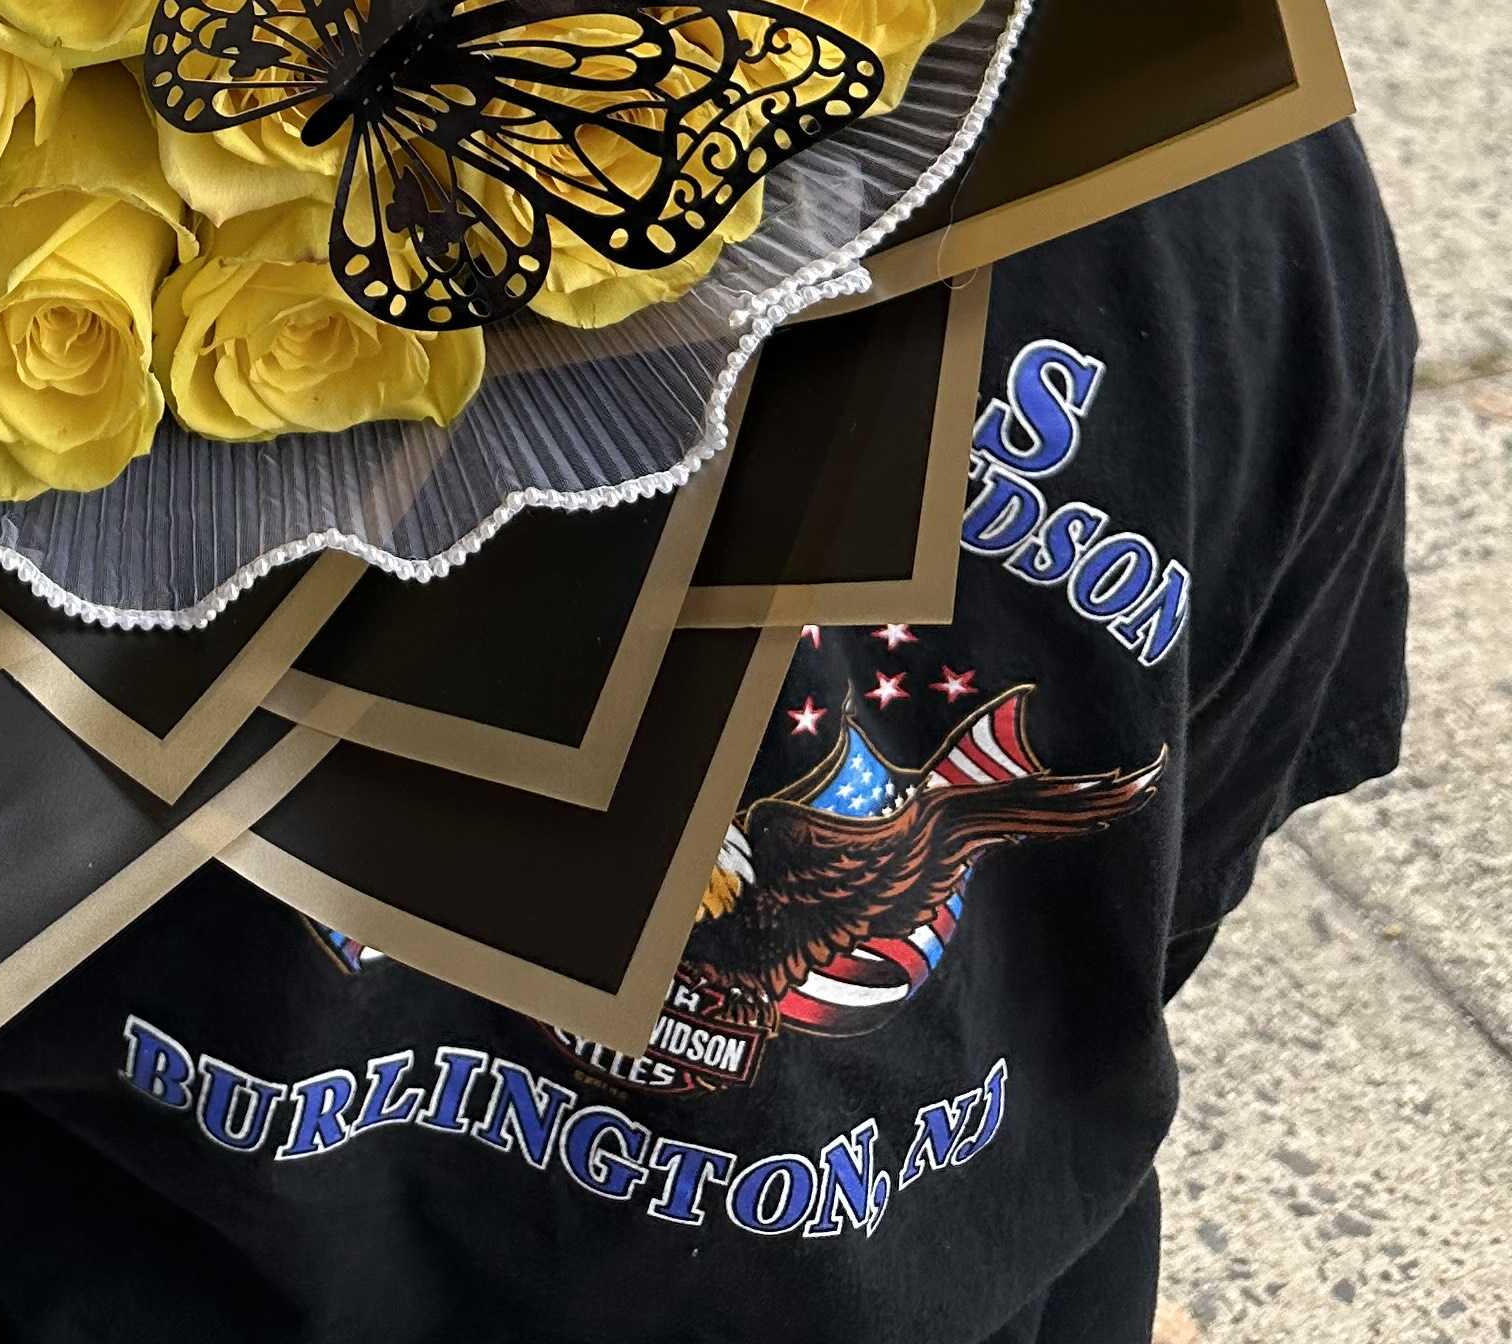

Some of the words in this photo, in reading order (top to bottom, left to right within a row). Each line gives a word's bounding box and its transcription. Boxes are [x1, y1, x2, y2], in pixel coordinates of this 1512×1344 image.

[960, 454, 1190, 667] DSON
[122, 1015, 891, 1239] BURLINGTON,
[898, 1057, 1008, 1191] NJ
